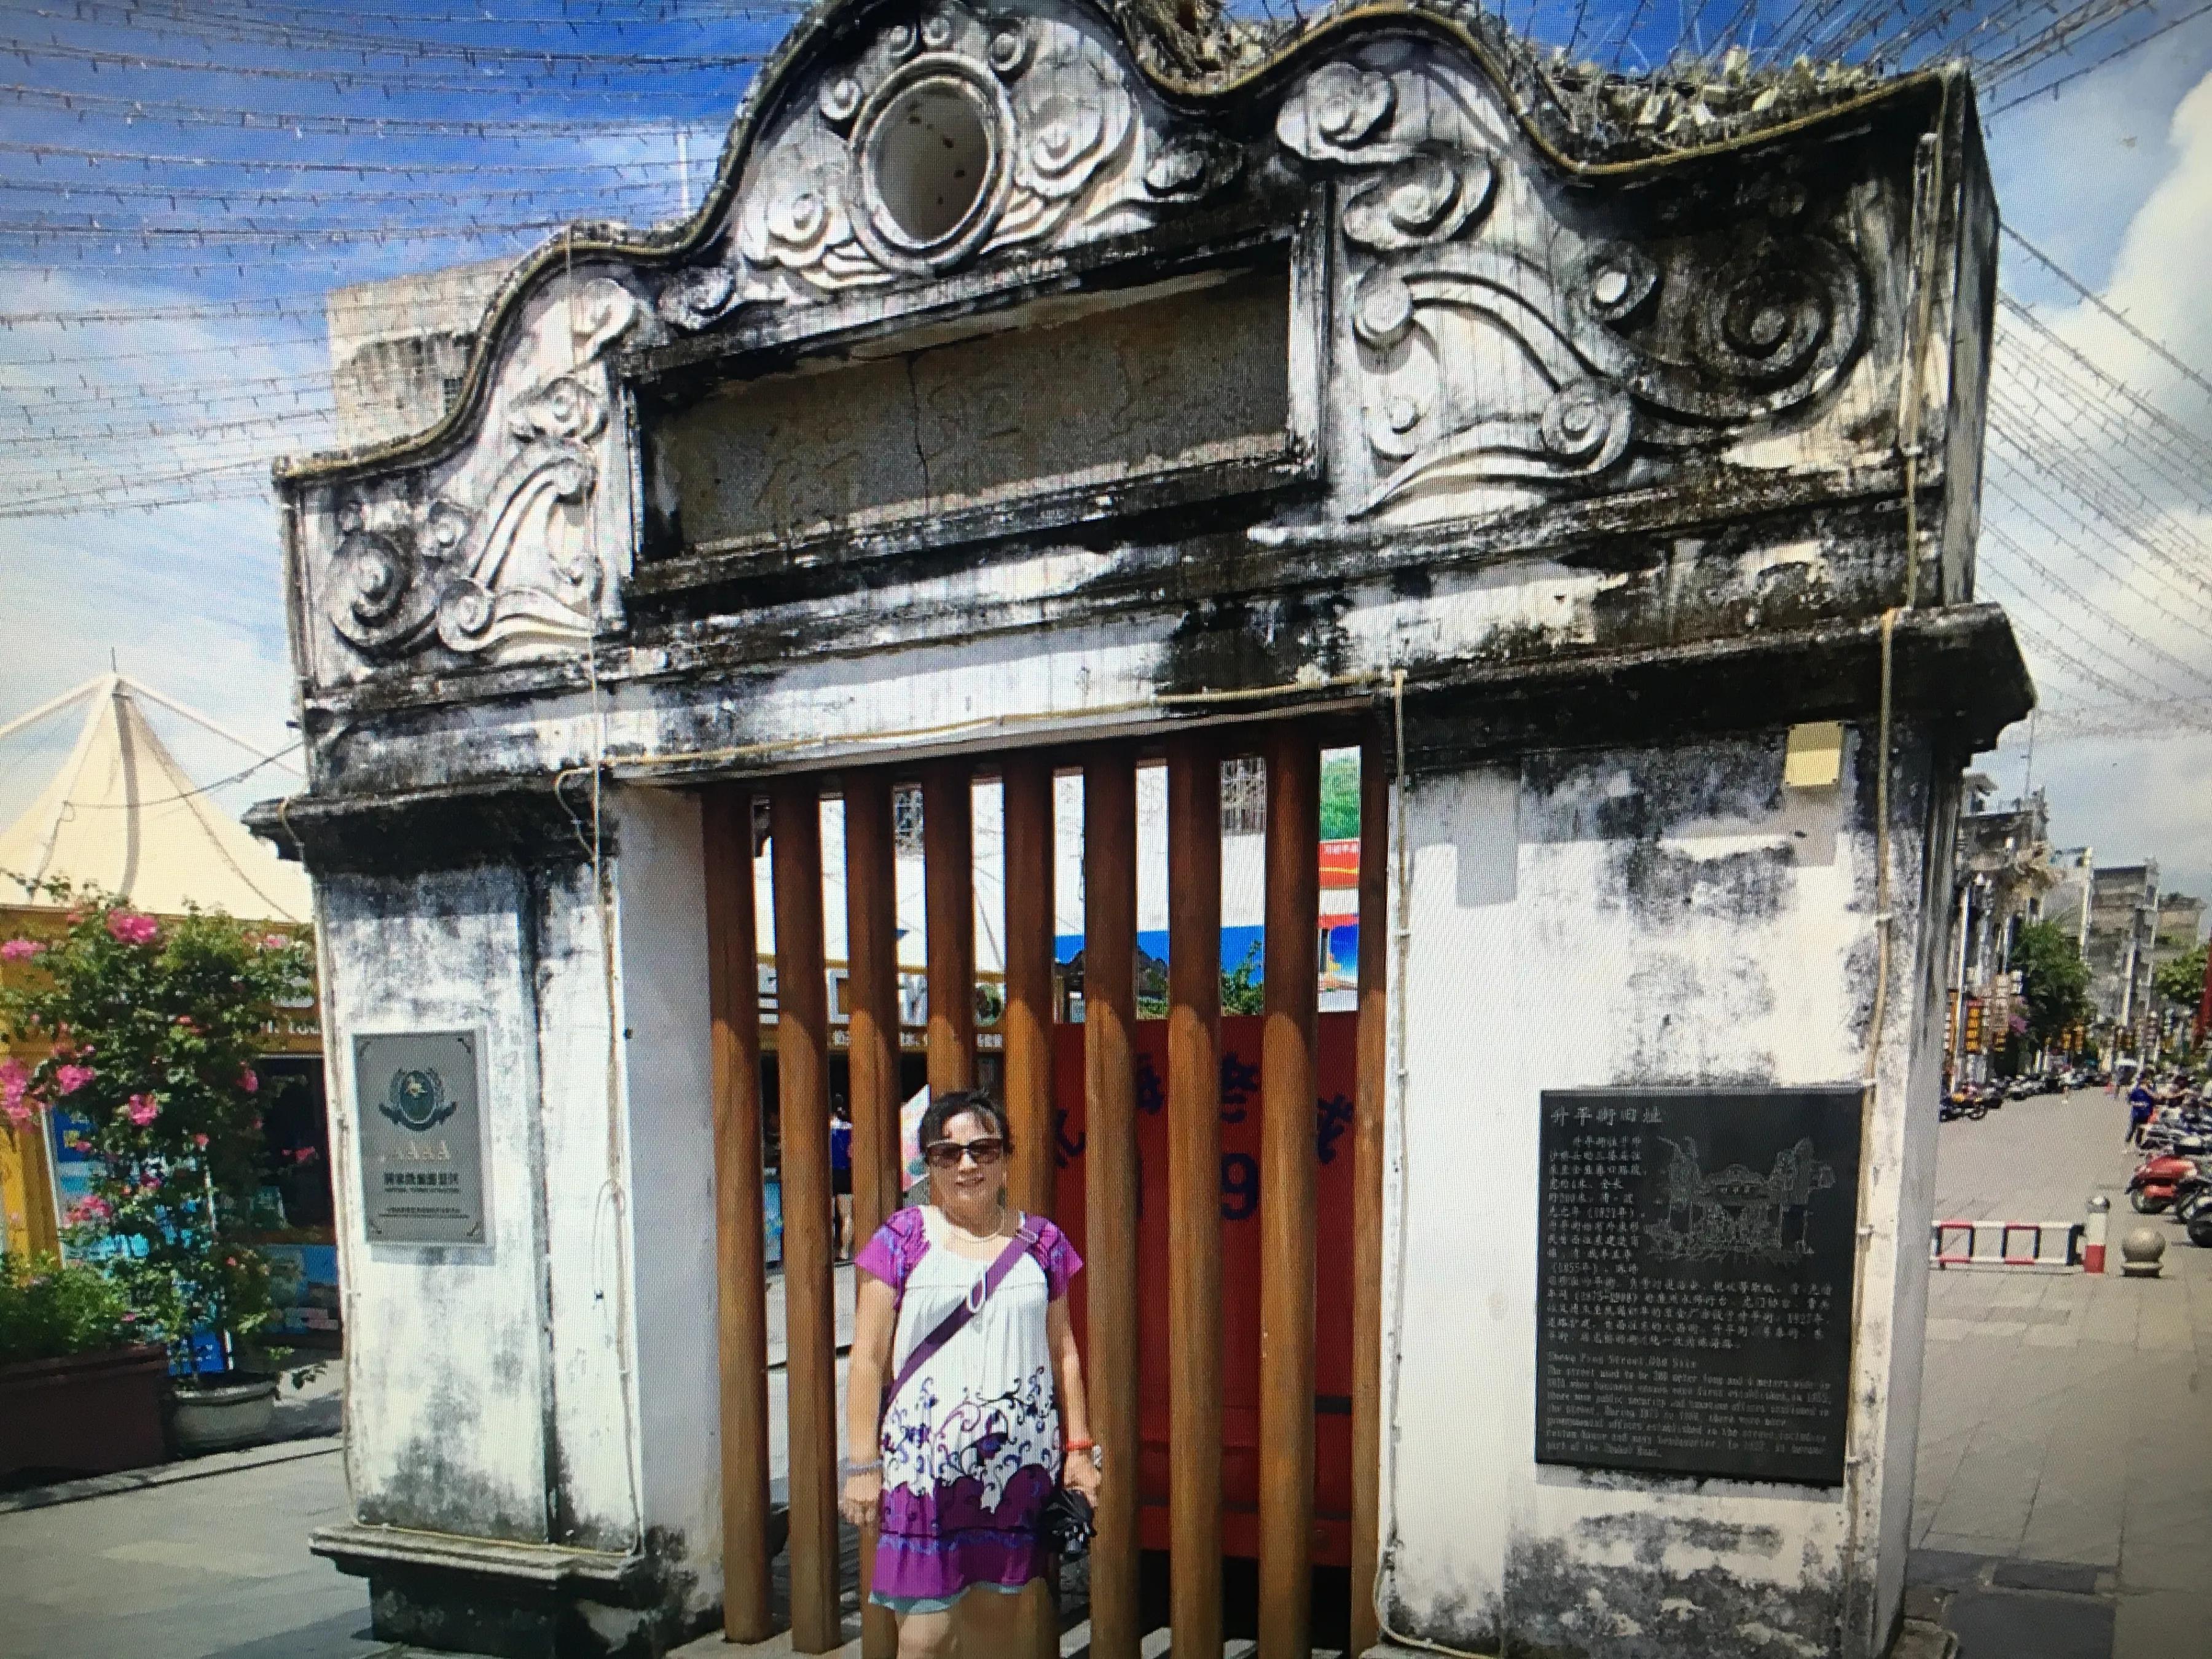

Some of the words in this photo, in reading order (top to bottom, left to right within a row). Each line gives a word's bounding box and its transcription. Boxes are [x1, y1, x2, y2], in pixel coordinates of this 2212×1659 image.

[1550, 1105, 1663, 1127] 升平街旧址
